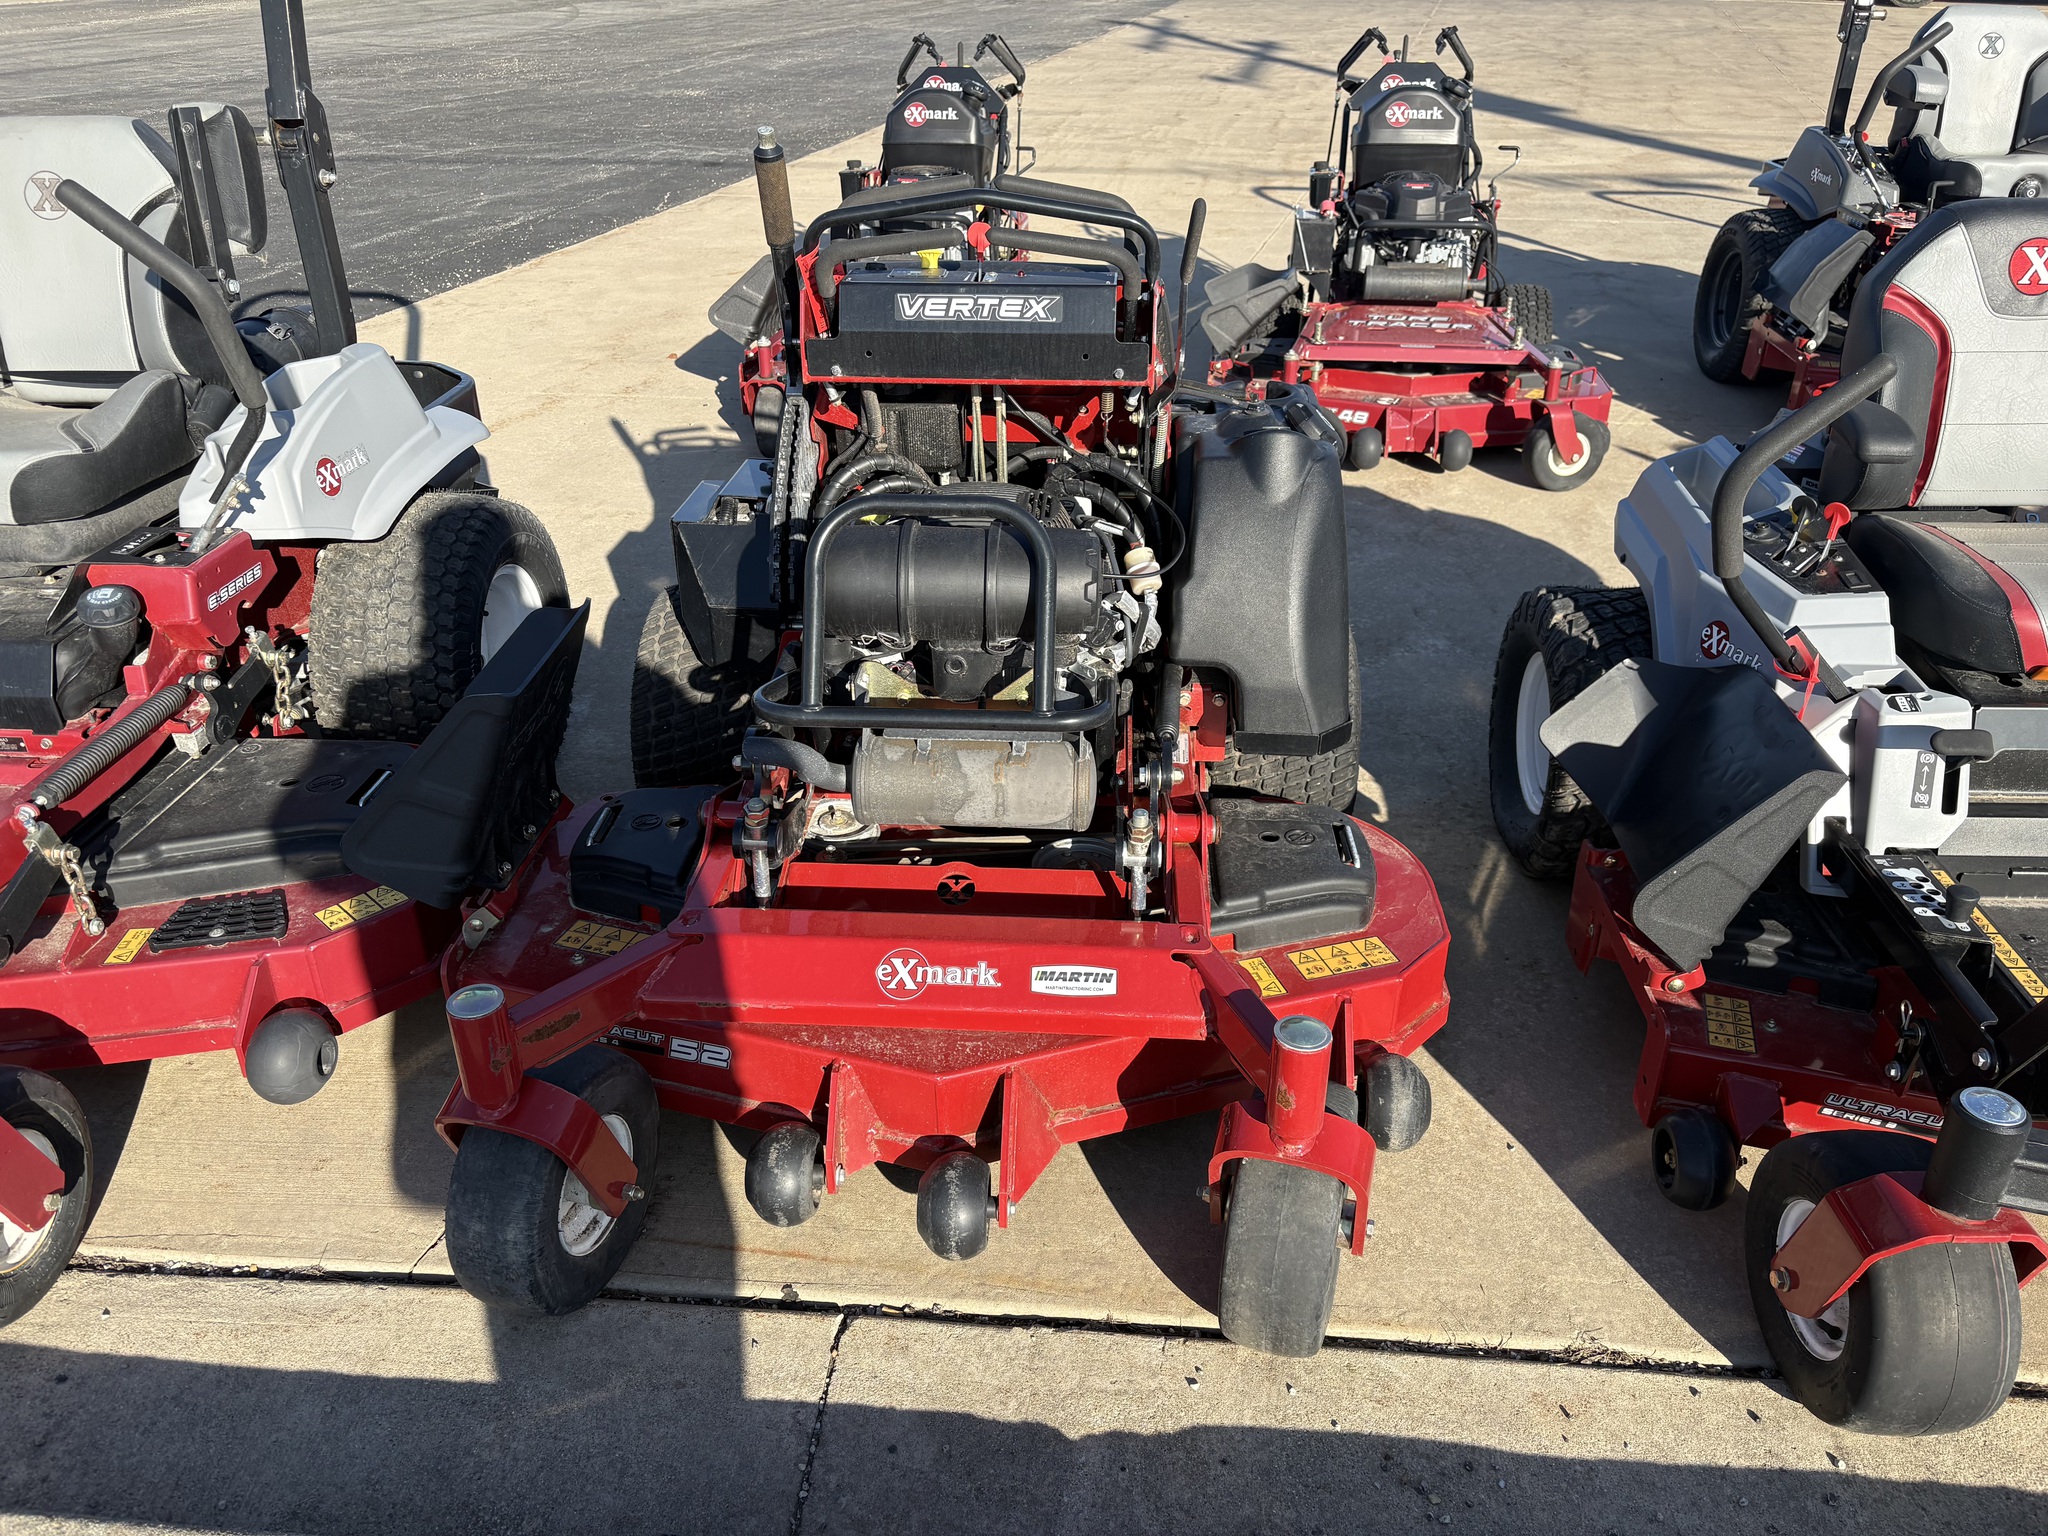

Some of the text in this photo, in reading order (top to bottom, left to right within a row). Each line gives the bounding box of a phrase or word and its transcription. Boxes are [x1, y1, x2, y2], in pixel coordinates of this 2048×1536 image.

[897, 294, 1058, 322] VERTEX
[1347, 320, 1475, 329] TRACER
[1366, 314, 1452, 322] TURF
[1339, 409, 1369, 425] 48
[207, 562, 262, 611] E-SERIES
[1037, 970, 1114, 984] MARTIN
[607, 1025, 733, 1070] ACUT 52
[1821, 1107, 1883, 1126] SERIES
[1824, 1093, 1944, 1129] ULTRACU
